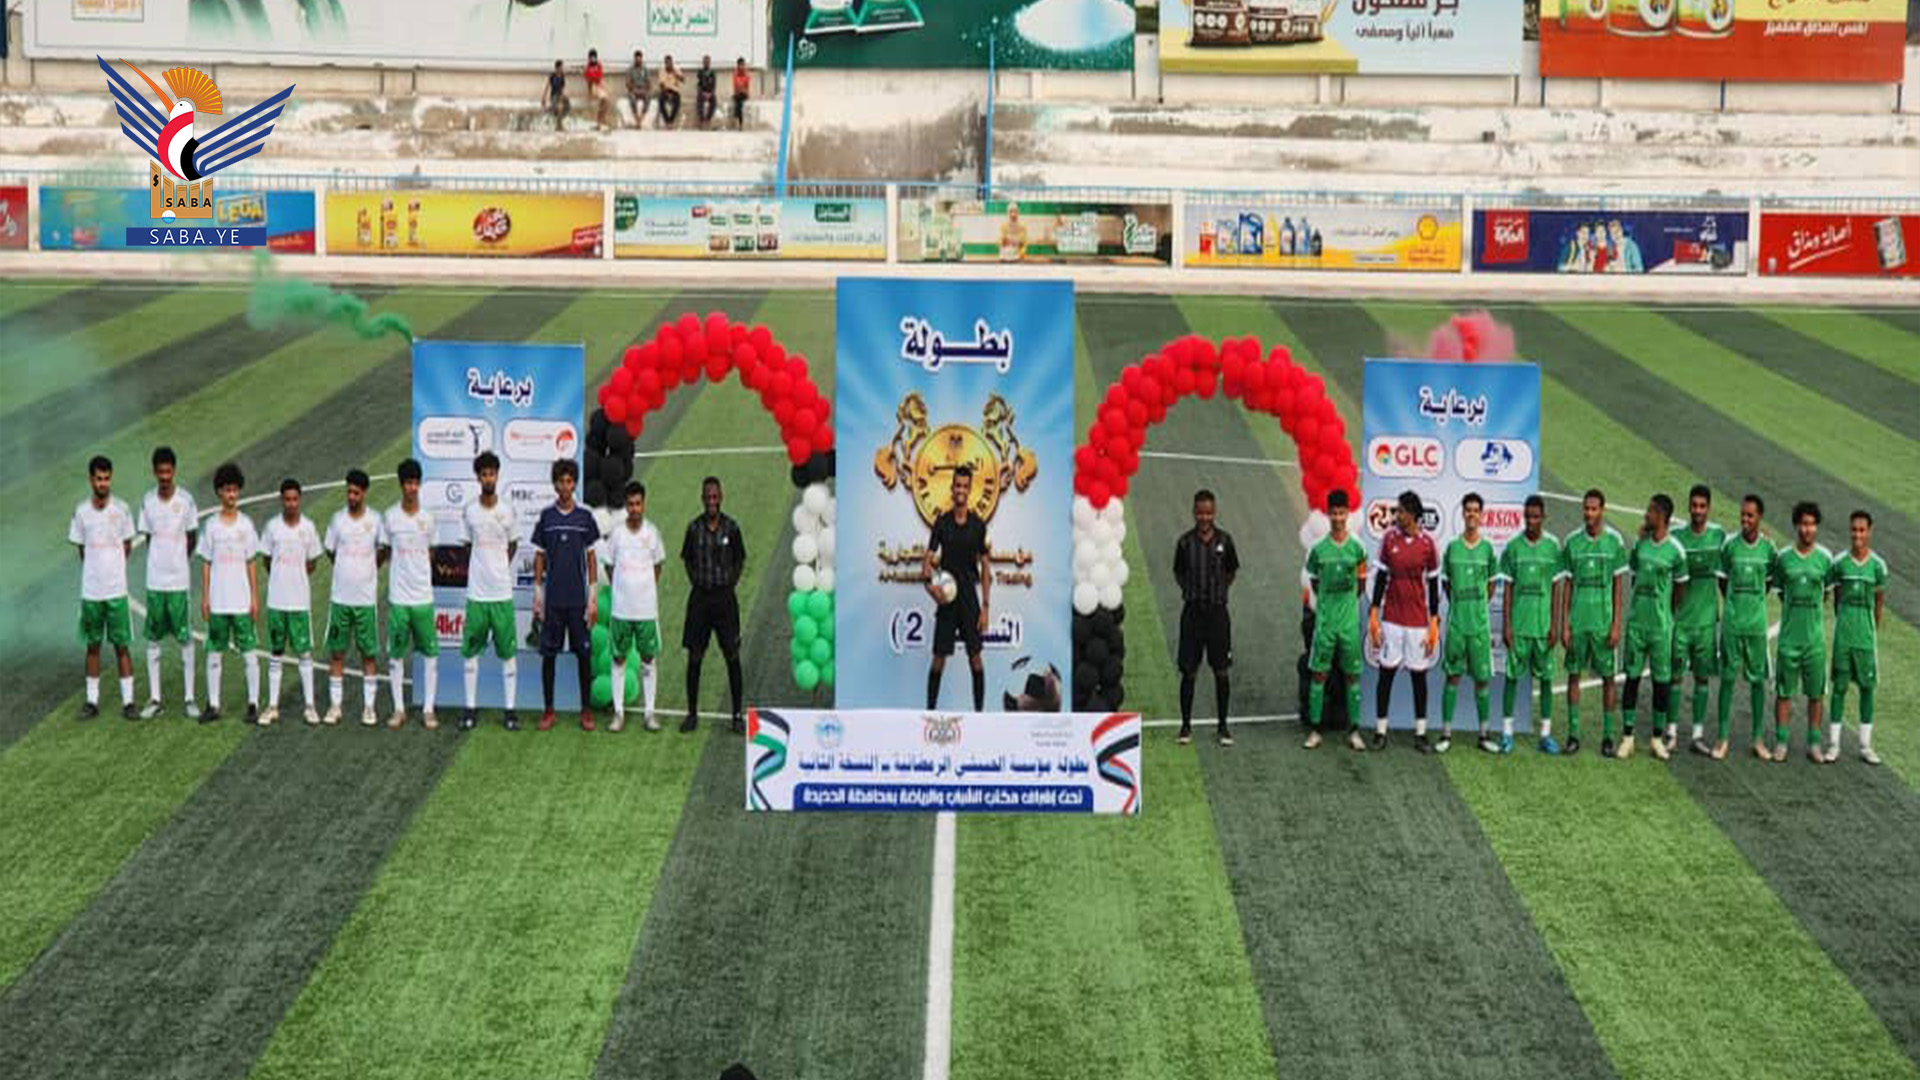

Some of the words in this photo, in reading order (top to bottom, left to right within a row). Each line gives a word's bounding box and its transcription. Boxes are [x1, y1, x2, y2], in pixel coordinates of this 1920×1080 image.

[903, 319, 1010, 371] بطولة
[469, 370, 532, 405] برعاية
[1421, 388, 1486, 423] برعاية
[1395, 445, 1437, 467] GLC
[799, 754, 834, 773] الثانية
[840, 753, 879, 772] النسخة
[895, 754, 950, 776] الرمضانية
[1010, 754, 1053, 777] مؤسسة
[1058, 756, 1089, 778] بطولة
[803, 787, 845, 806] الحديدة
[850, 788, 898, 807] بمحافظة
[900, 788, 944, 807] والرياضة
[947, 789, 983, 807] الشباب
[984, 790, 1018, 806] مكتب
[1058, 790, 1083, 805] تحت
